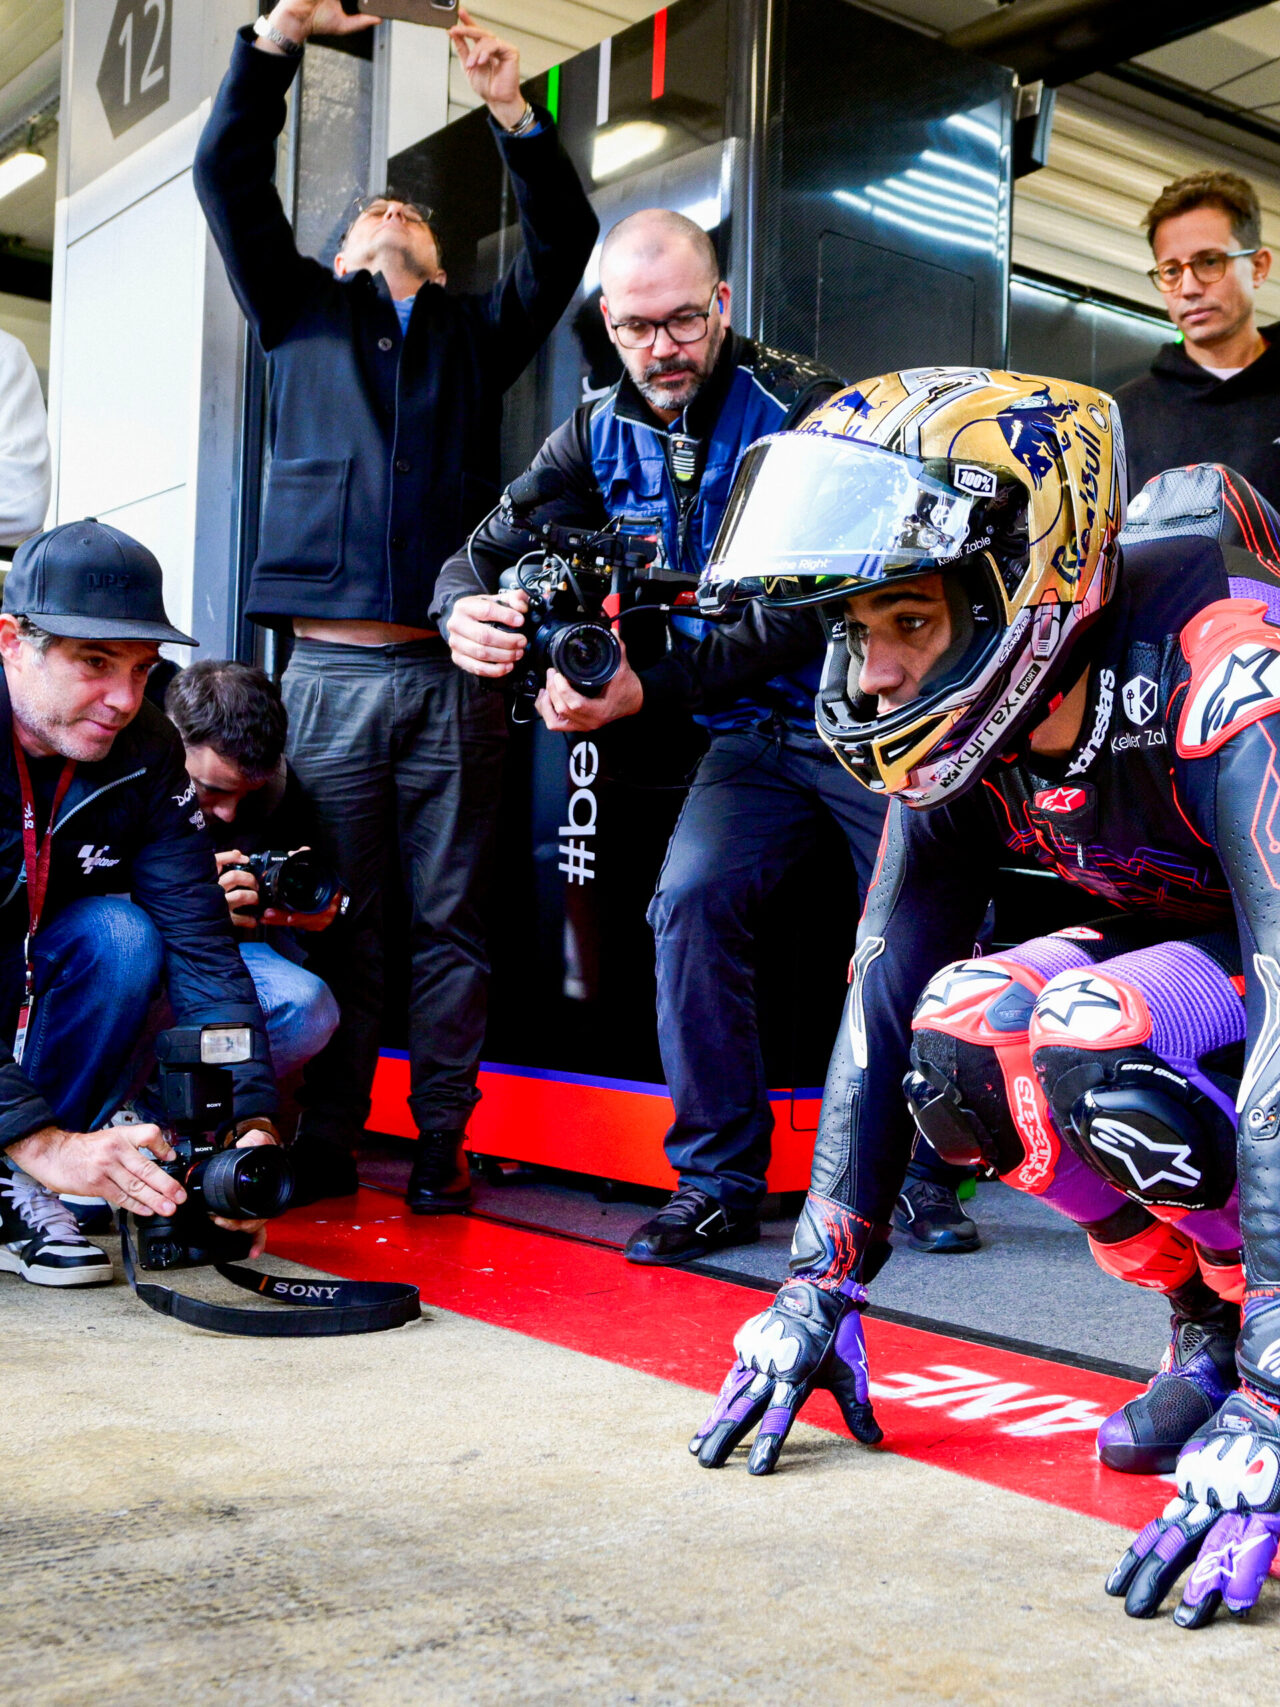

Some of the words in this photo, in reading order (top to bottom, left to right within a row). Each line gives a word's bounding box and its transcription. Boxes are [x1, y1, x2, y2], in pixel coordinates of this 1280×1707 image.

[119, 0, 166, 107] 12
[960, 469, 991, 492] 100%
[964, 536, 991, 554] Zable
[799, 558, 828, 570] Right
[1019, 666, 1040, 692] SPORT
[1110, 733, 1141, 754] Keller
[1121, 1063, 1154, 1072] one
[273, 1282, 340, 1300] SONY
[868, 1364, 1112, 1438] ANE
